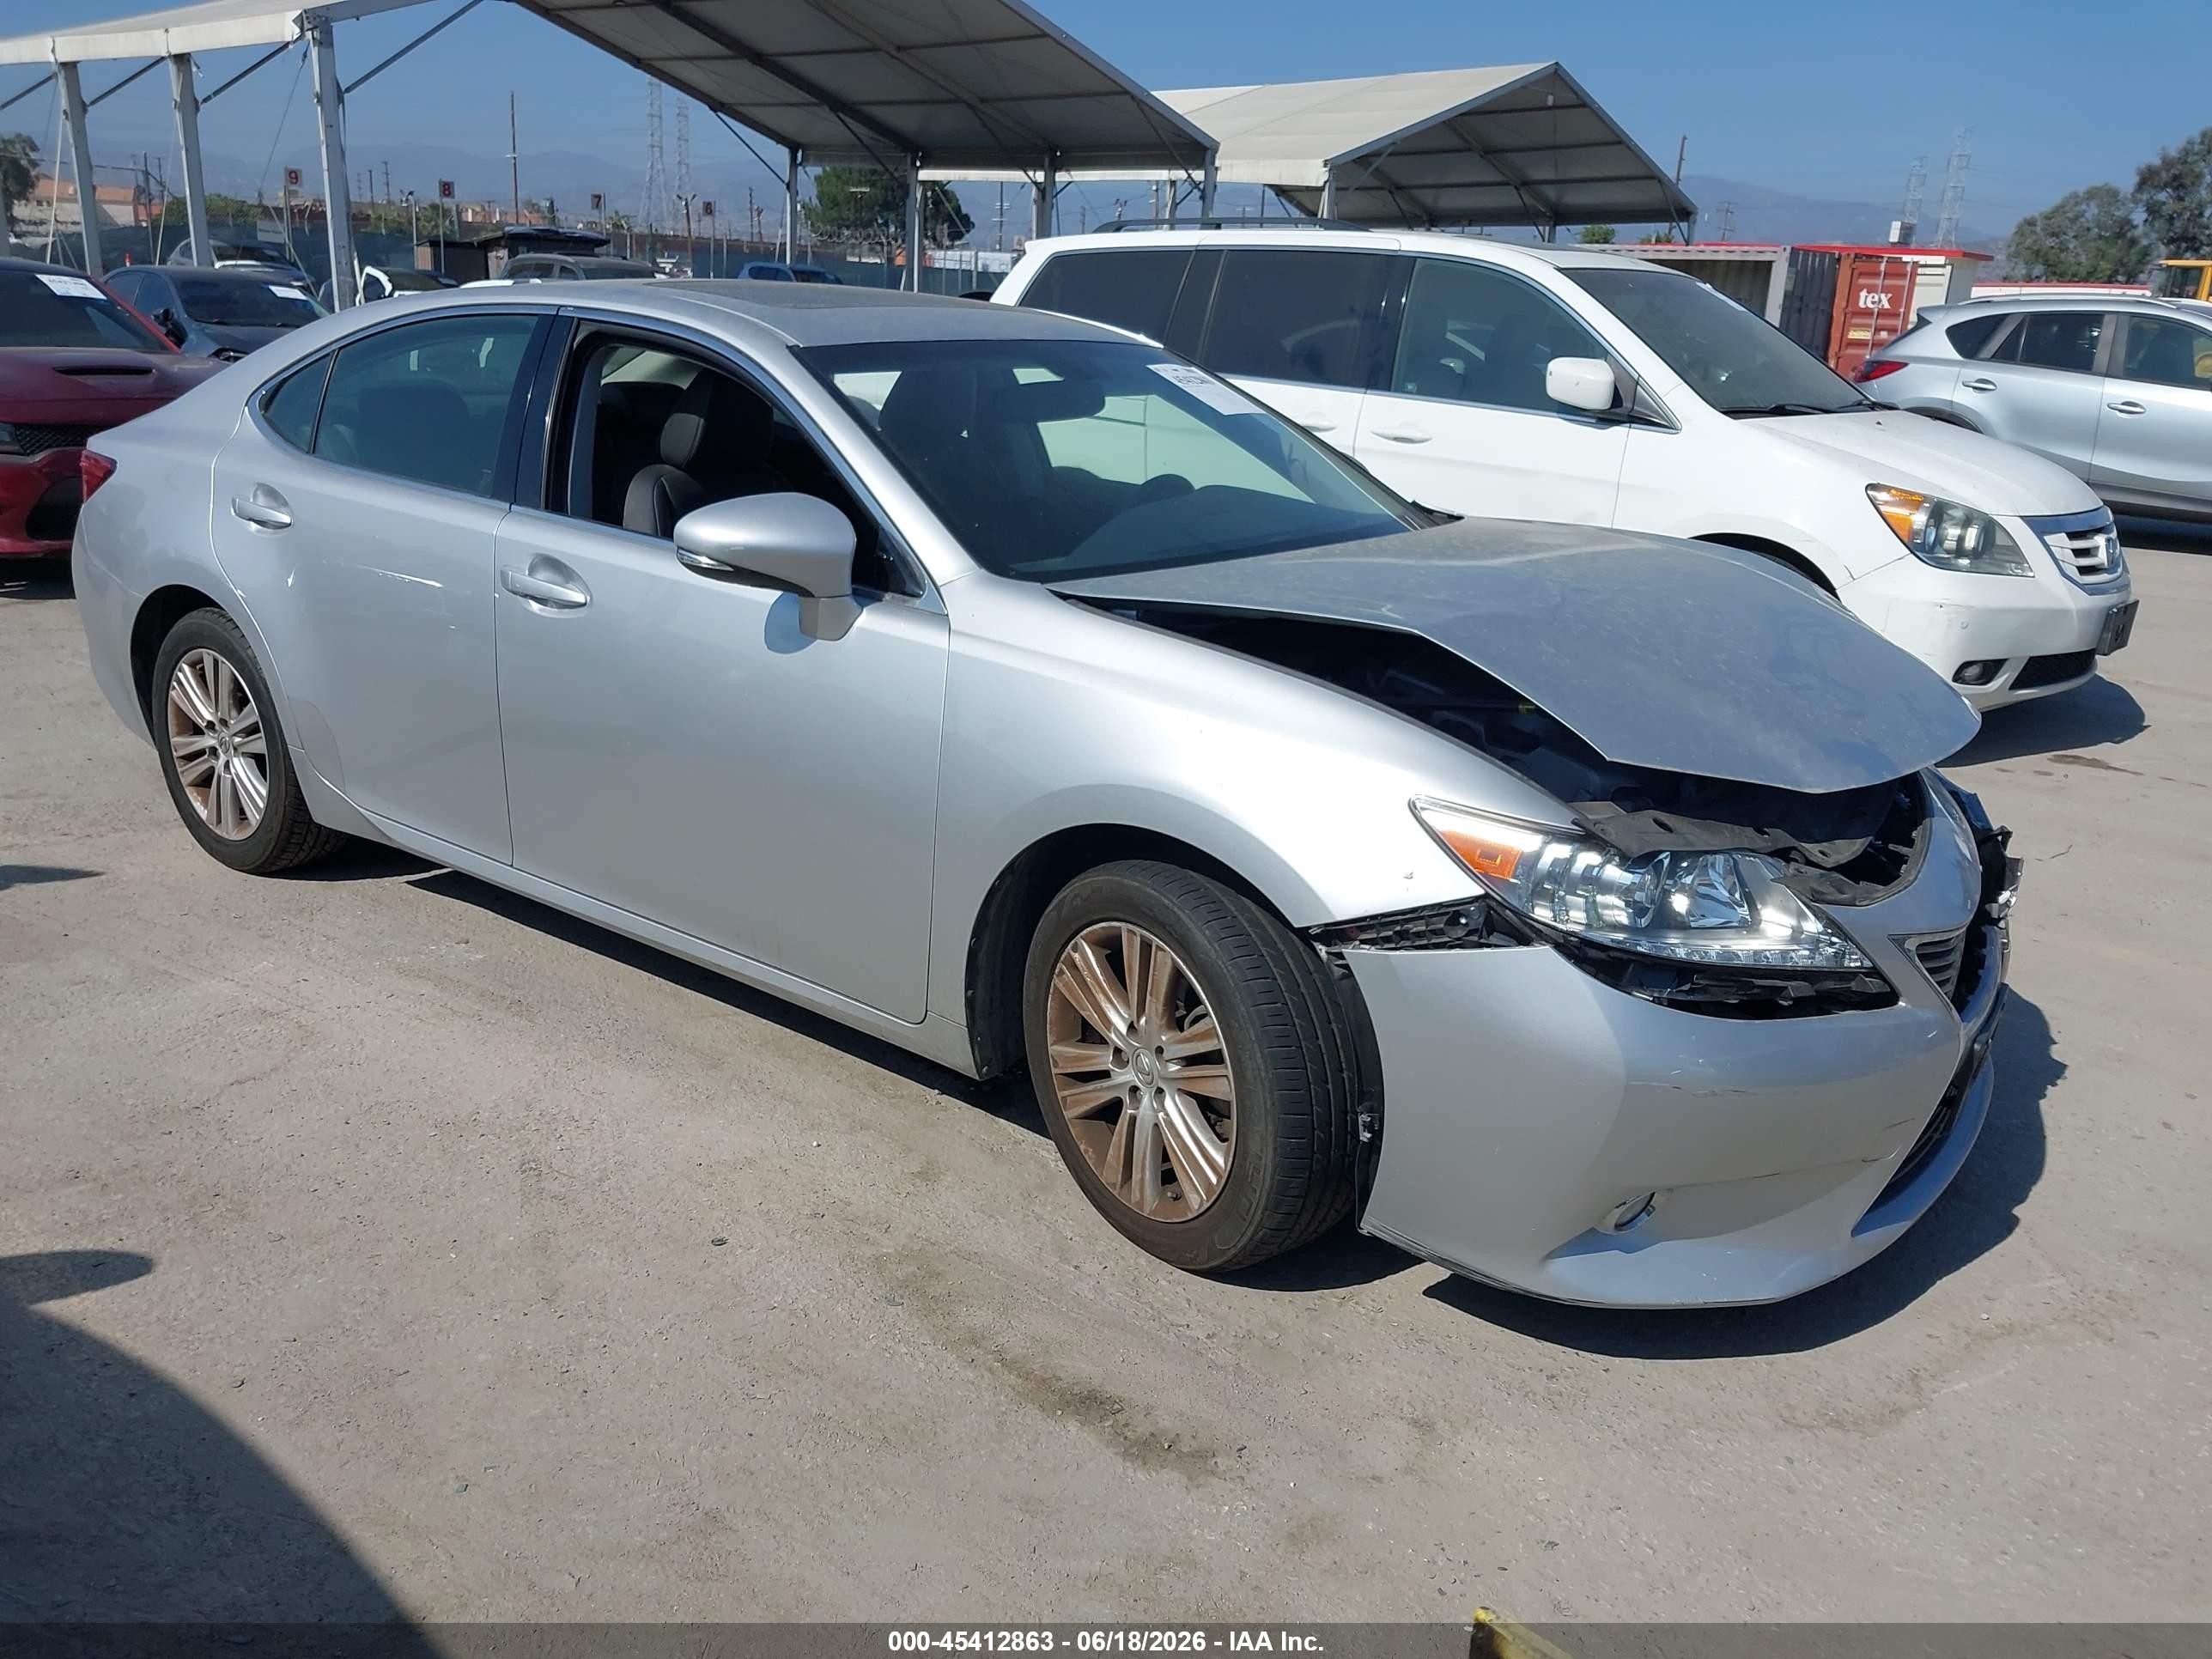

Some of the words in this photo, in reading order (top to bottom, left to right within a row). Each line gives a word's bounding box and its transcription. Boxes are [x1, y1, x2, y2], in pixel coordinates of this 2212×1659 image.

[289, 170, 299, 185] 9
[442, 182, 452, 198] 8
[592, 194, 602, 209] 7
[1858, 289, 1893, 309] tex
